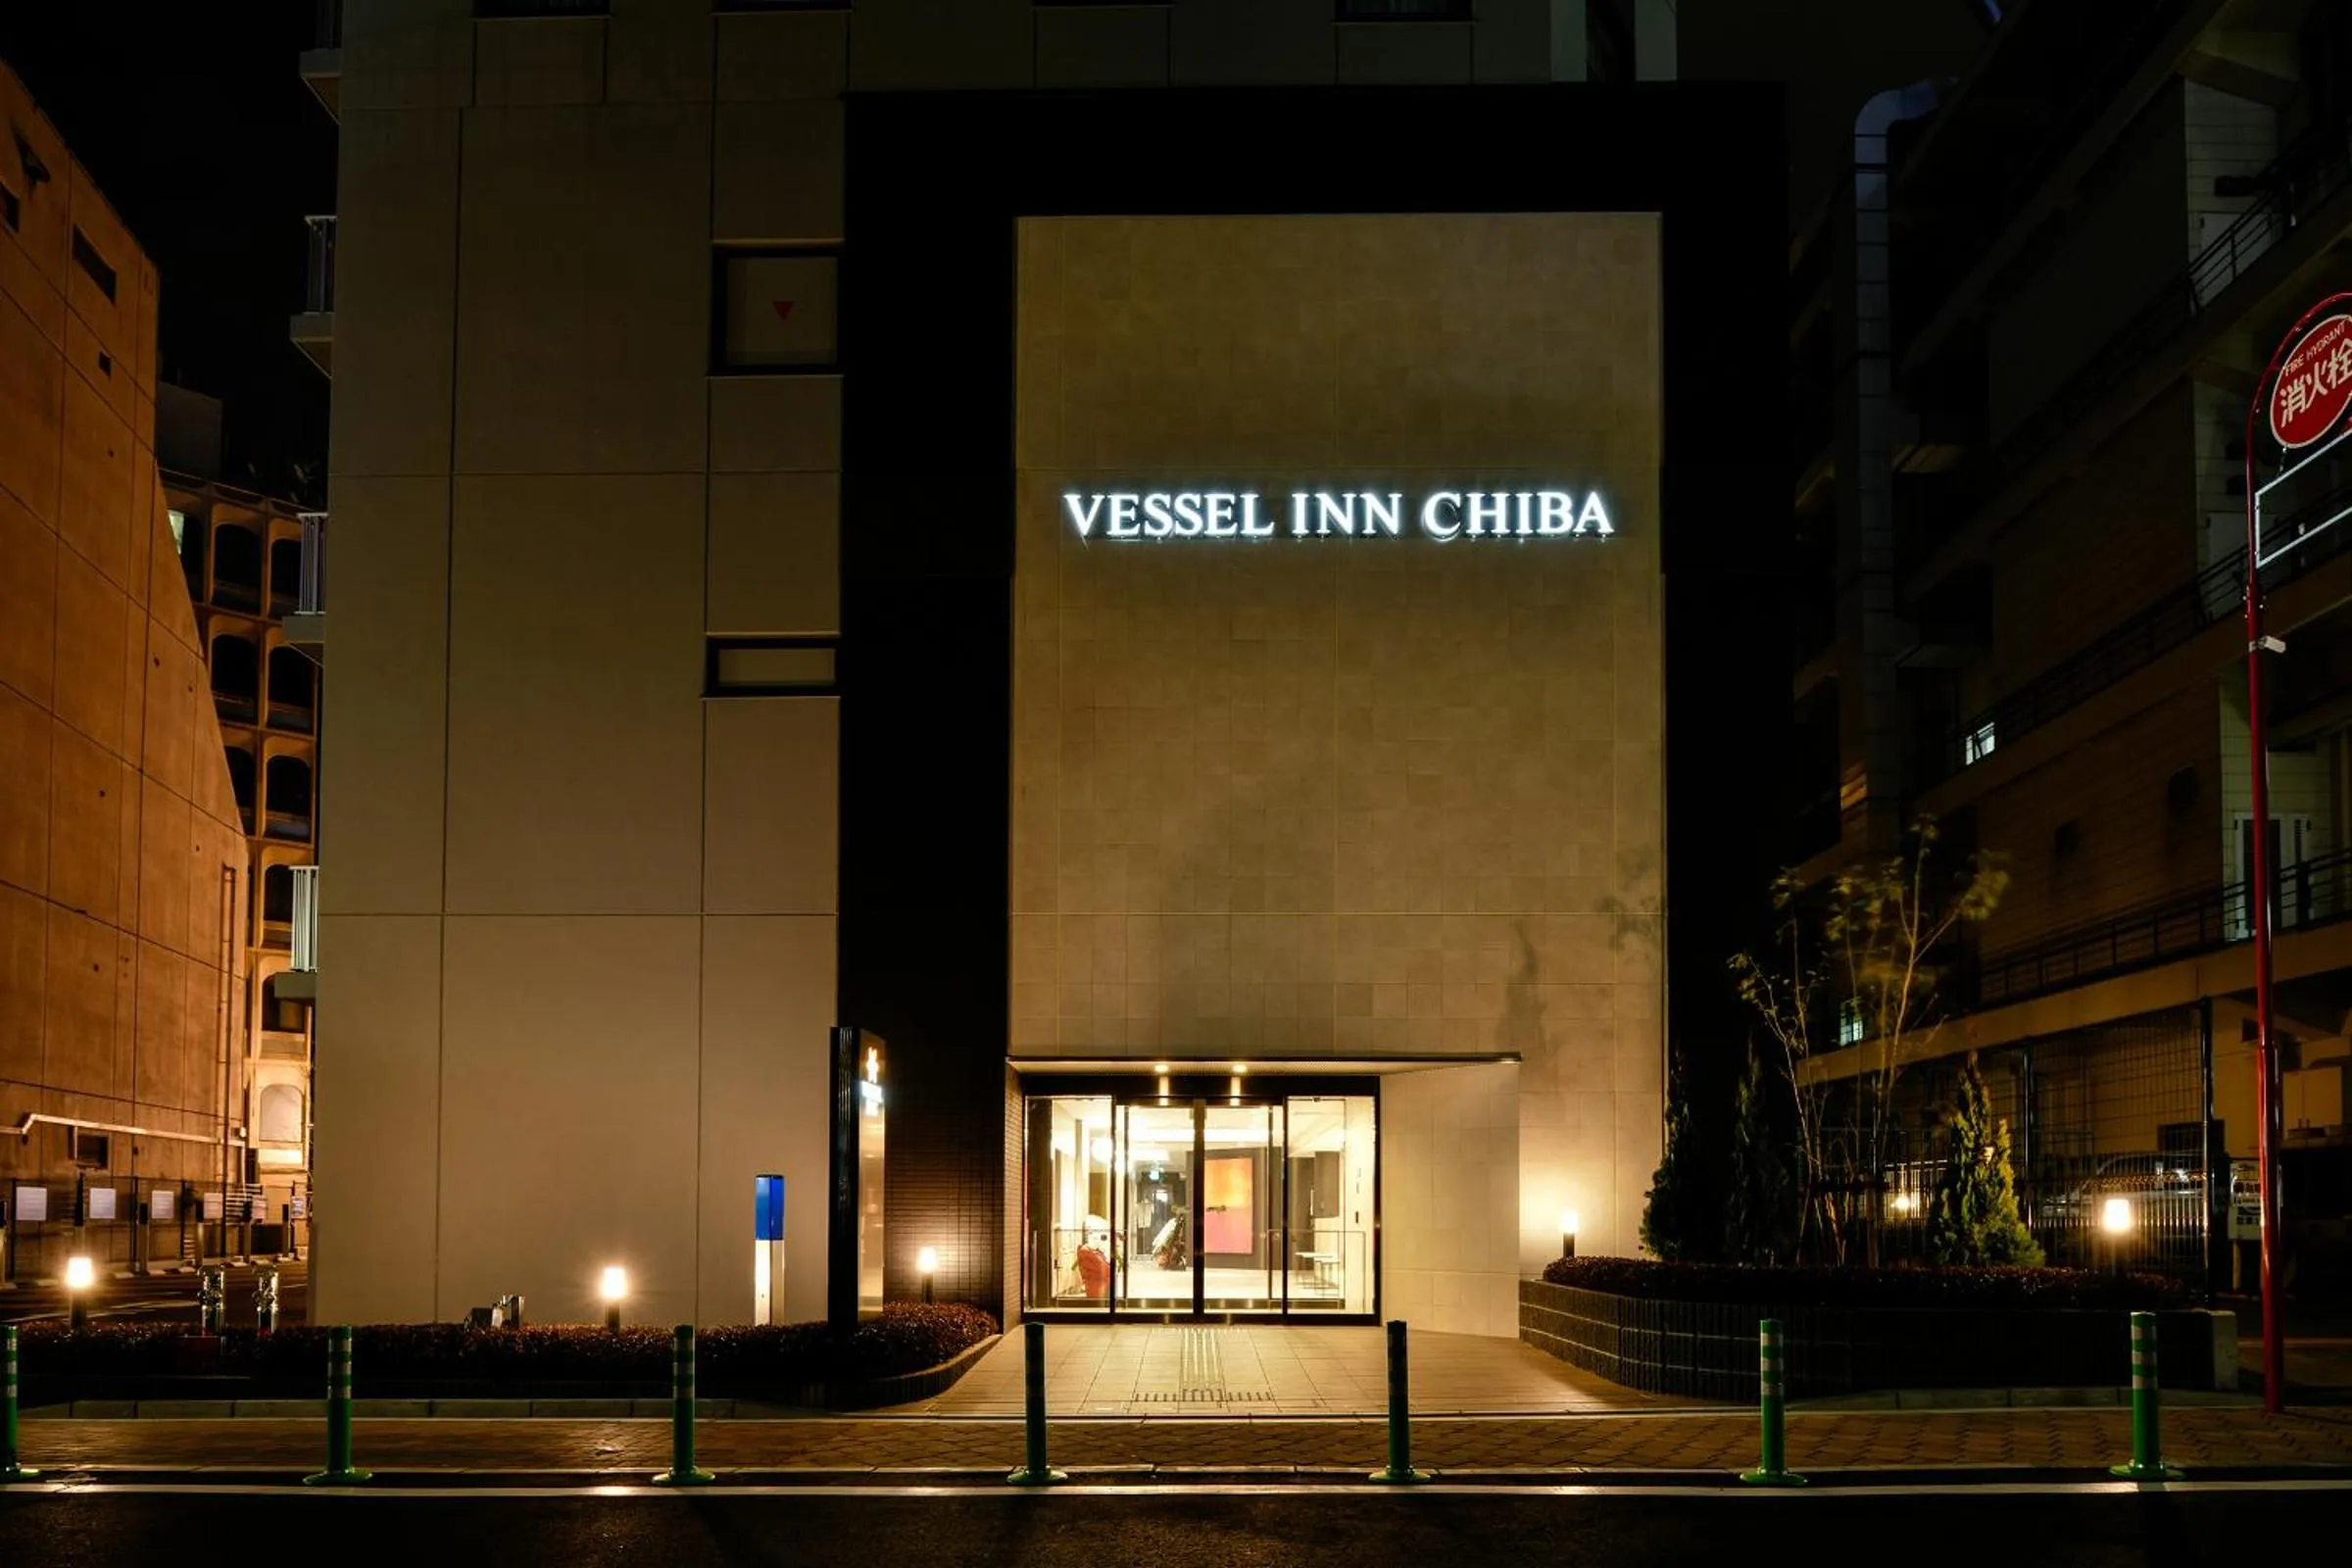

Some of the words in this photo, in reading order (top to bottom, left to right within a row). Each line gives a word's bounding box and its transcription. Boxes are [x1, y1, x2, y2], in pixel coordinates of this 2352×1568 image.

[2284, 353, 2305, 377] FIRE
[2306, 320, 2346, 362] HYDRANT
[1063, 493, 1276, 537] VESSEL
[1291, 492, 1402, 535] INN
[1423, 491, 1615, 537] CHIBA
